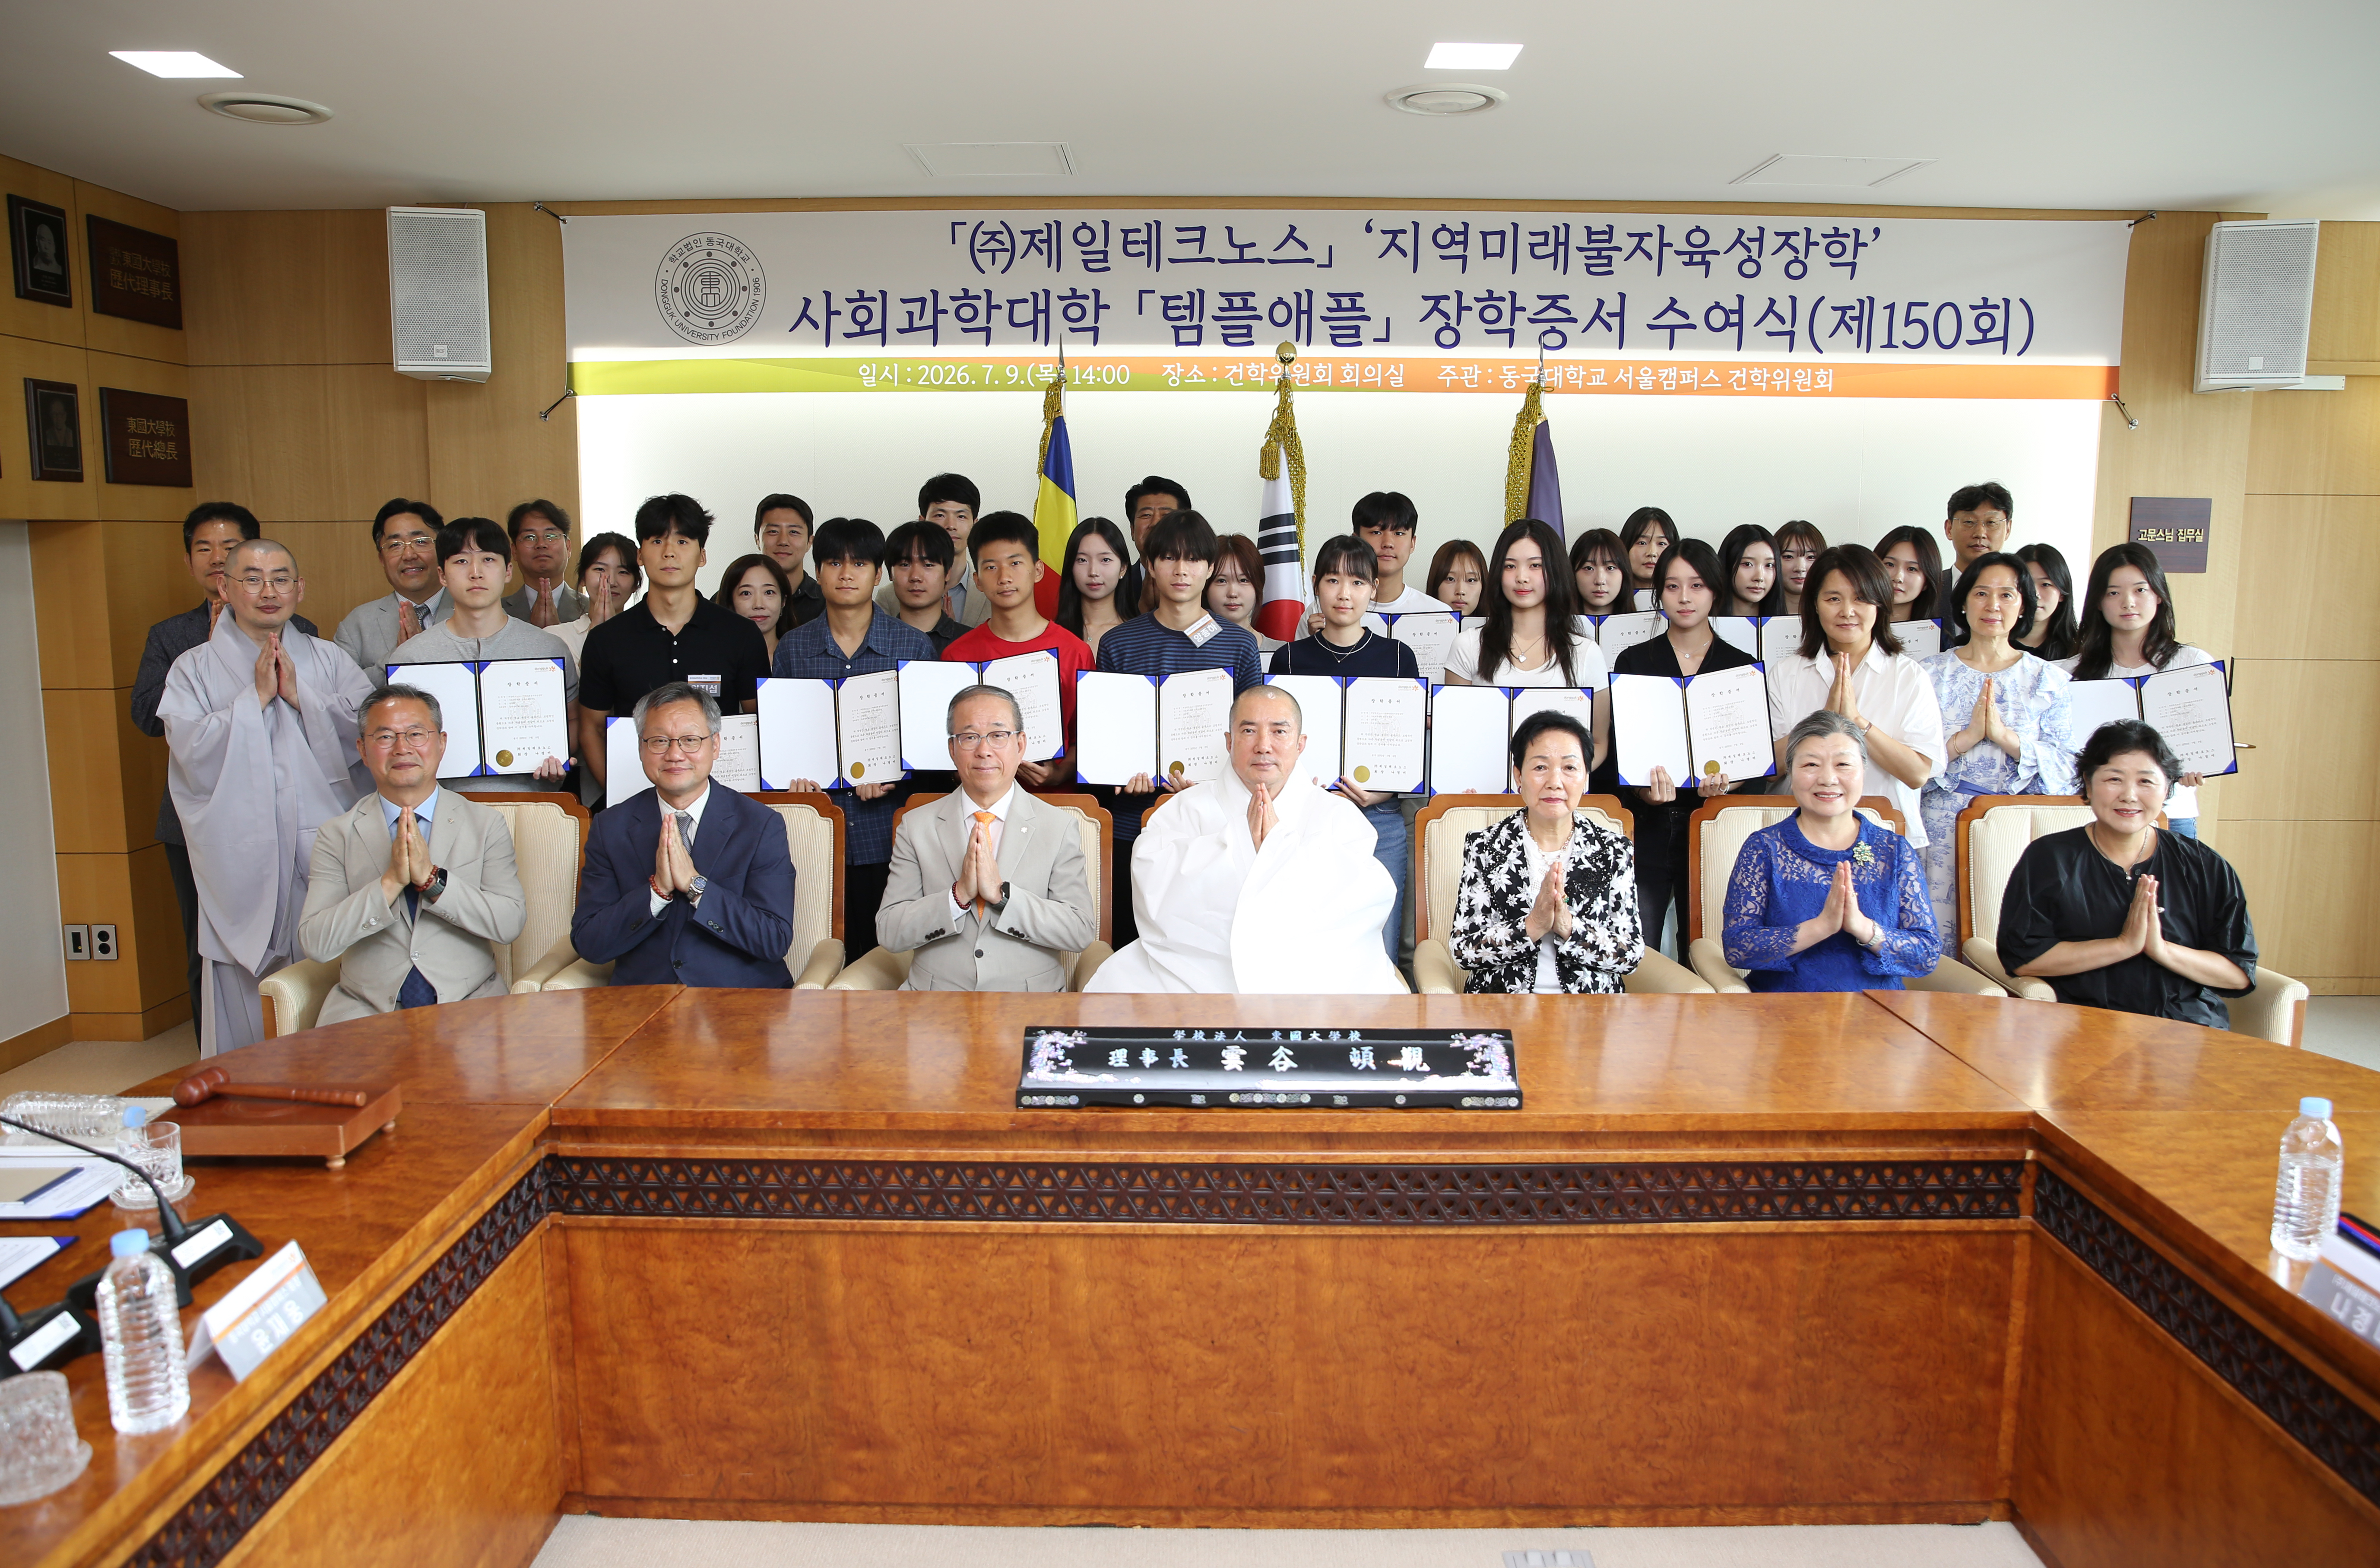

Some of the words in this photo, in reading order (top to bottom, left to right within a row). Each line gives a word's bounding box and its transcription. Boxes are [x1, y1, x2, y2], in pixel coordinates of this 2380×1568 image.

[669, 238, 702, 263] 학교법인
[706, 237, 750, 263] 동국대학교
[661, 279, 677, 321] DONGGUK
[675, 319, 719, 341] UNIVERSITY
[722, 298, 759, 339] FOUNDATION
[752, 277, 761, 296] 1906
[789, 289, 1110, 348] 사회과학대학
[1138, 289, 1390, 348] 「템플애플」
[1420, 290, 1627, 351] 장학증서
[1646, 295, 2035, 357] 수여식(제150회)
[859, 363, 898, 387] 일시
[918, 365, 976, 384] 2026.
[1006, 363, 1065, 388] 9.(목
[1073, 365, 1130, 384] 14:00
[1162, 362, 1206, 387] 장소
[1340, 363, 1404, 387] 회의실
[1437, 364, 1482, 388] 주관
[1498, 365, 1608, 389] 동국대학교
[1614, 366, 1721, 390] 서울캠퍼스
[1728, 367, 1833, 392] 건학위원회
[127, 417, 175, 437] 東國大學校
[129, 438, 178, 460] 歷代總長
[2138, 528, 2174, 542] 고문스님
[2177, 528, 2204, 543] 집무실
[1193, 623, 1218, 642] 양종하
[1108, 1047, 1189, 1069] 理事長
